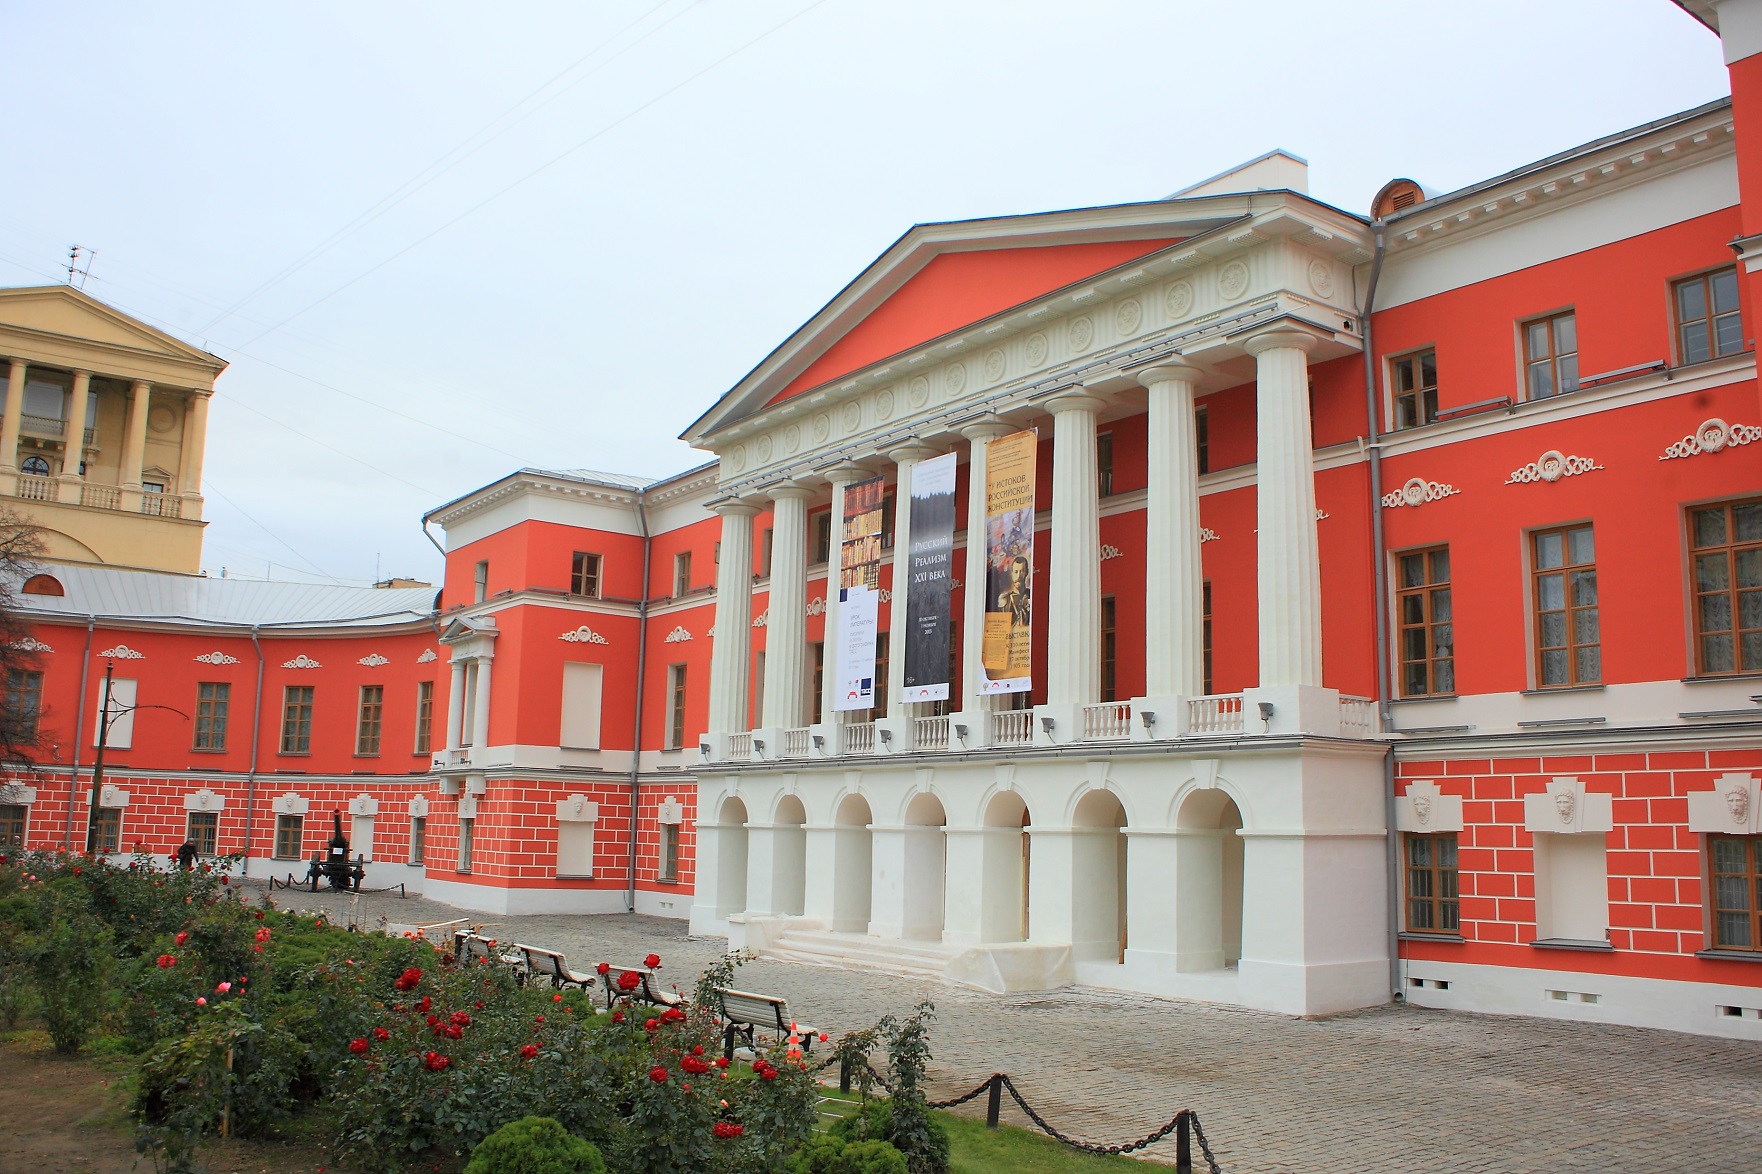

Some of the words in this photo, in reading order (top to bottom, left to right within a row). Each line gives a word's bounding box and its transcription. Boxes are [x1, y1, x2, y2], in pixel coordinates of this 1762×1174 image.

[996, 475, 1026, 488] ИСТОКОВ
[988, 483, 1030, 502] РОССИЙСКОЙ
[987, 494, 1033, 513] КОНСТИТУЦИИ
[915, 535, 948, 551] РУССКИЙ
[915, 553, 947, 567] РЕАЛИЗМ
[915, 572, 927, 583] XXI
[929, 570, 946, 580] ВЕКА
[1005, 631, 1030, 640] ВЫСТАВК
[1009, 648, 1030, 656] Манифест
